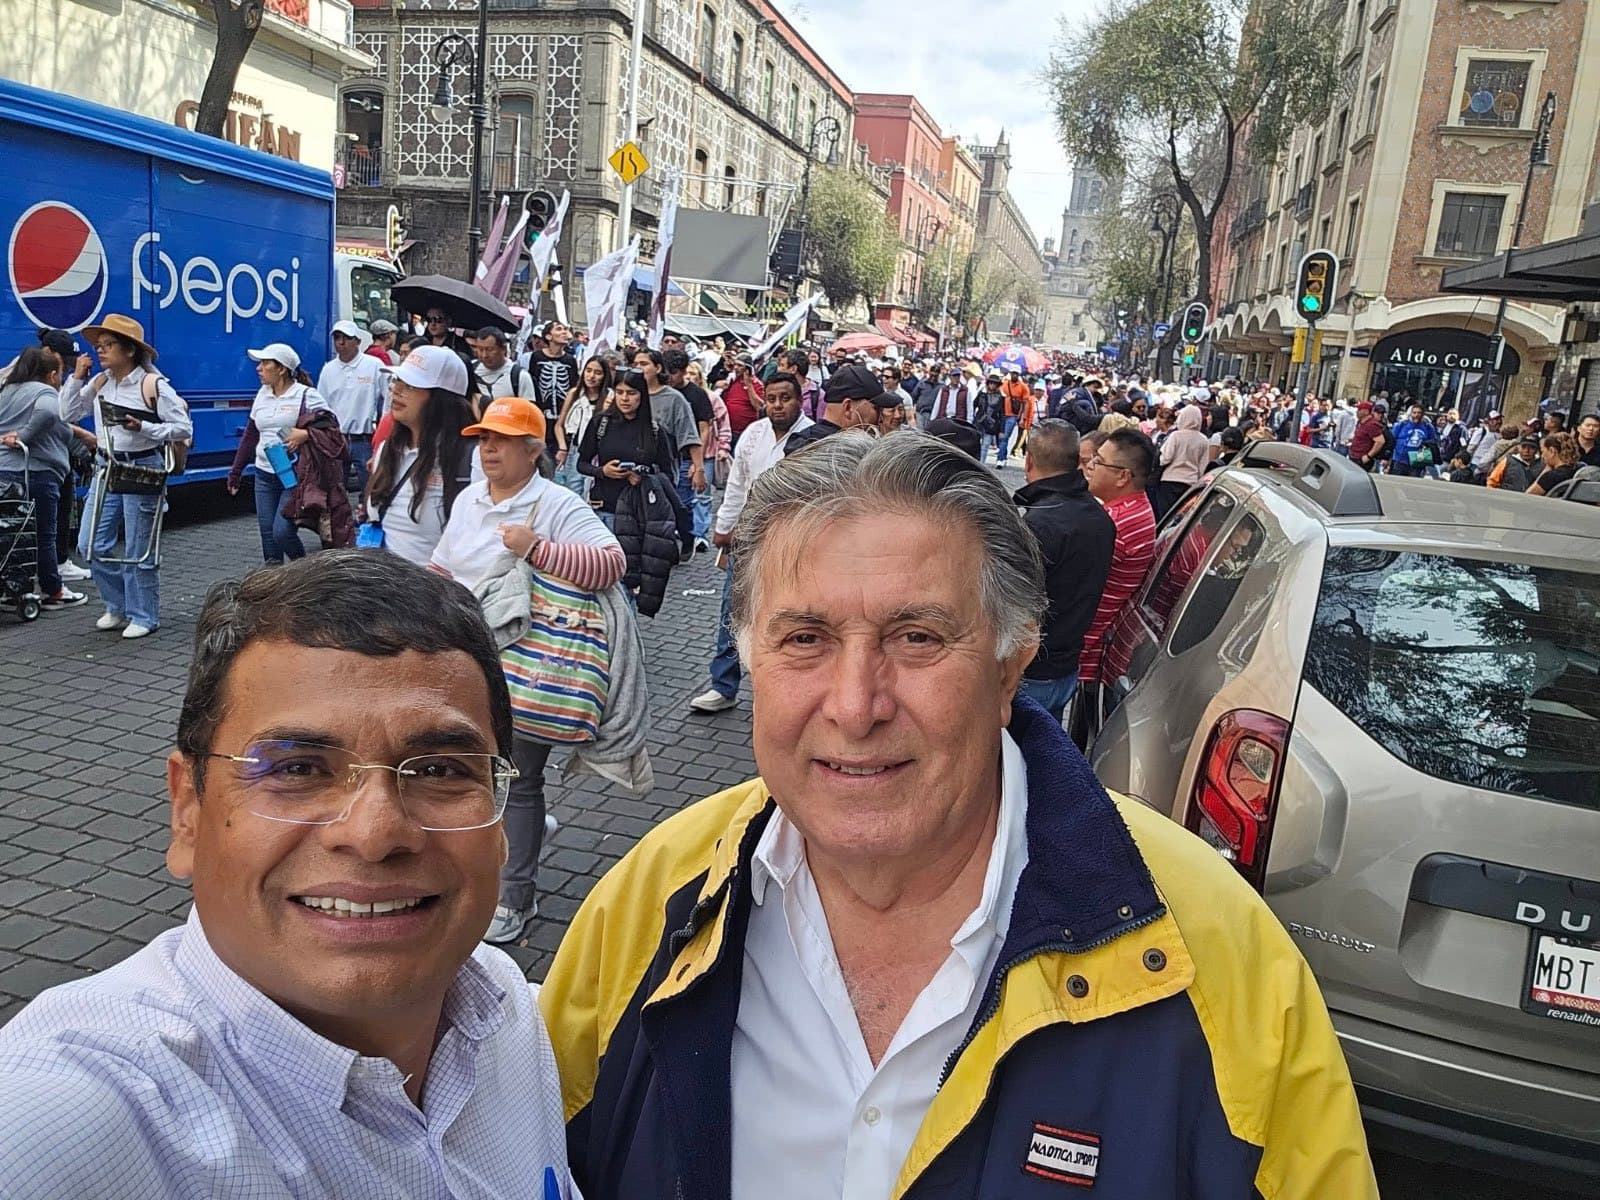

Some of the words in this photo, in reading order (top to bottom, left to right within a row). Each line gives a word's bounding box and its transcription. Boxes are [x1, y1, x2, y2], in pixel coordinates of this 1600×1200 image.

[132, 231, 300, 334] pepsi
[1390, 347, 1437, 364] Aldo
[1444, 353, 1483, 369] Con
[1289, 922, 1376, 953] RENAULT
[1073, 1151, 1098, 1167] SPORT
